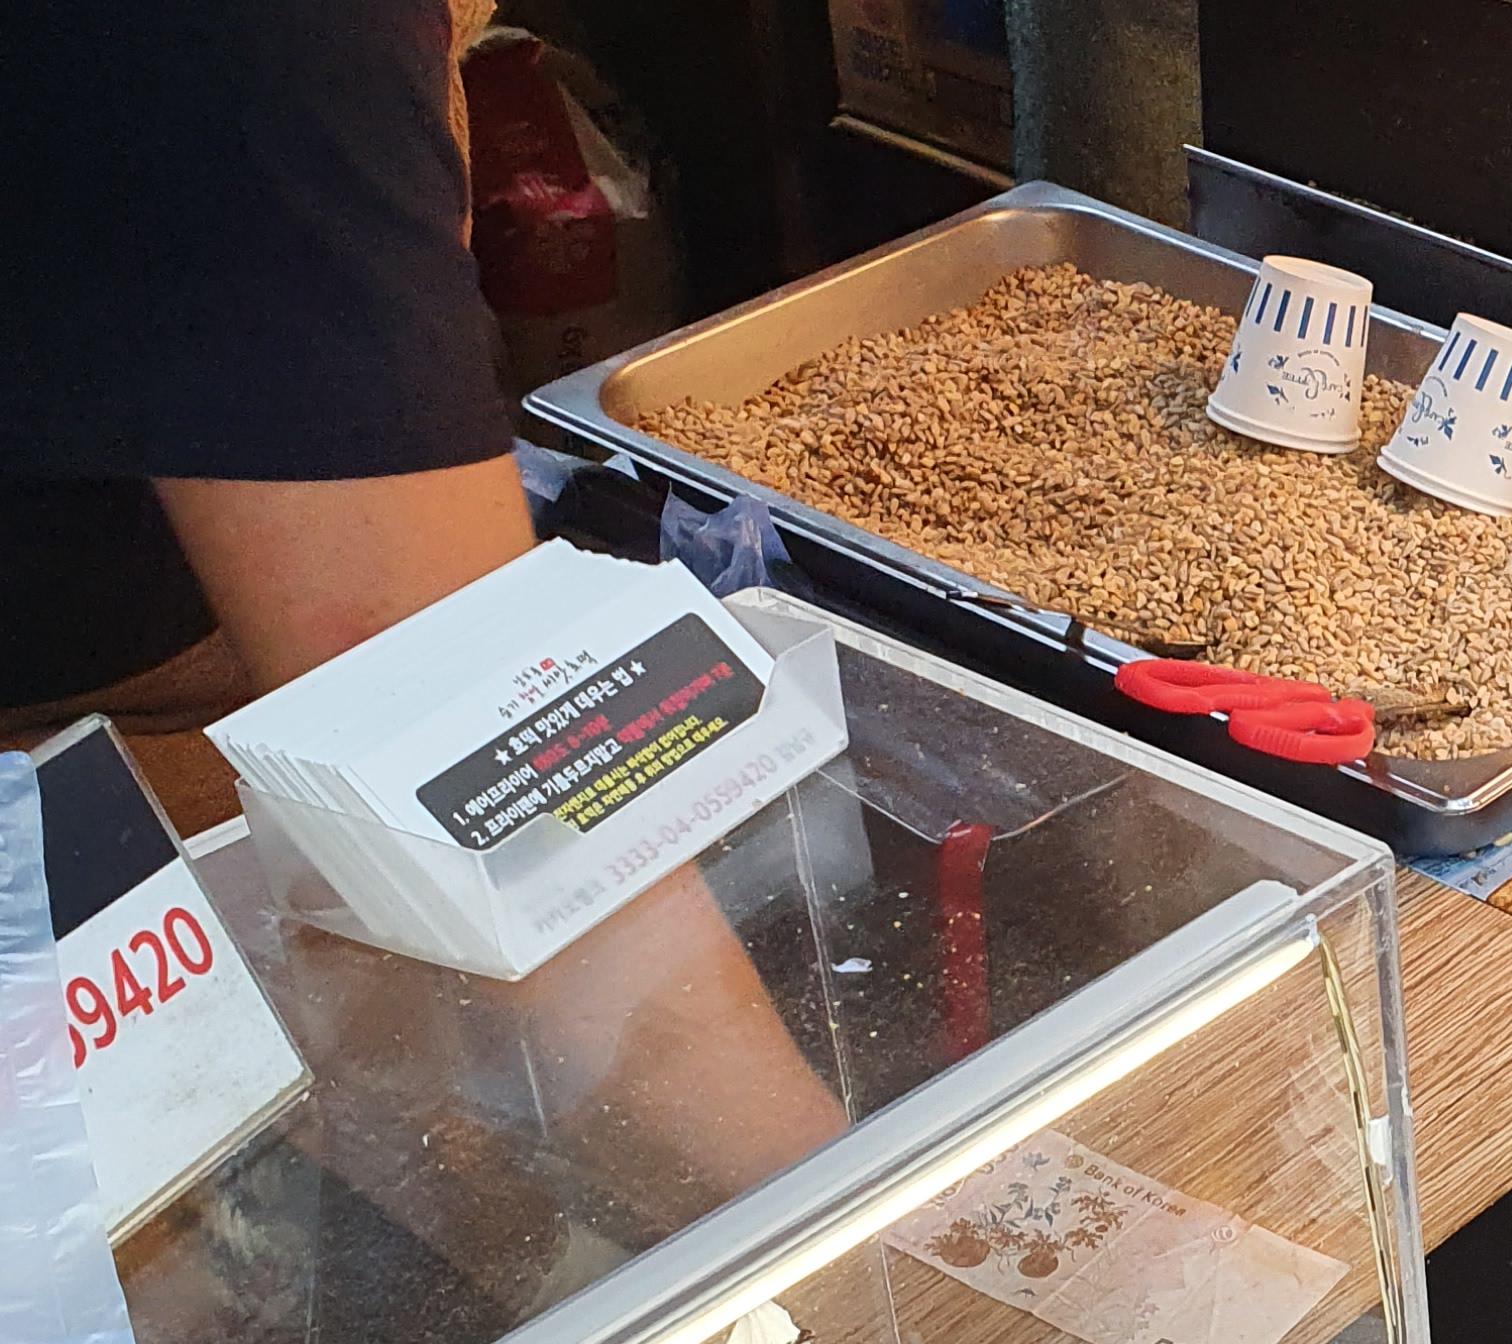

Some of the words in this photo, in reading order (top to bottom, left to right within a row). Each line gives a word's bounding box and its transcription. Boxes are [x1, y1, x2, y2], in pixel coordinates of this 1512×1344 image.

[507, 726, 543, 756] 호떡
[537, 703, 580, 739] 맛있게
[573, 680, 619, 711] 데우는
[611, 666, 634, 689] 법
[453, 811, 470, 827] 1.
[464, 762, 539, 818] 에어프라이어
[470, 827, 491, 848] 2.
[485, 788, 548, 837] 프라이팬에
[605, 754, 778, 885] 3333-04-0559420
[1084, 1163, 1123, 1193] Bank
[1123, 1181, 1143, 1200] of
[1141, 1190, 1186, 1219] Korea
